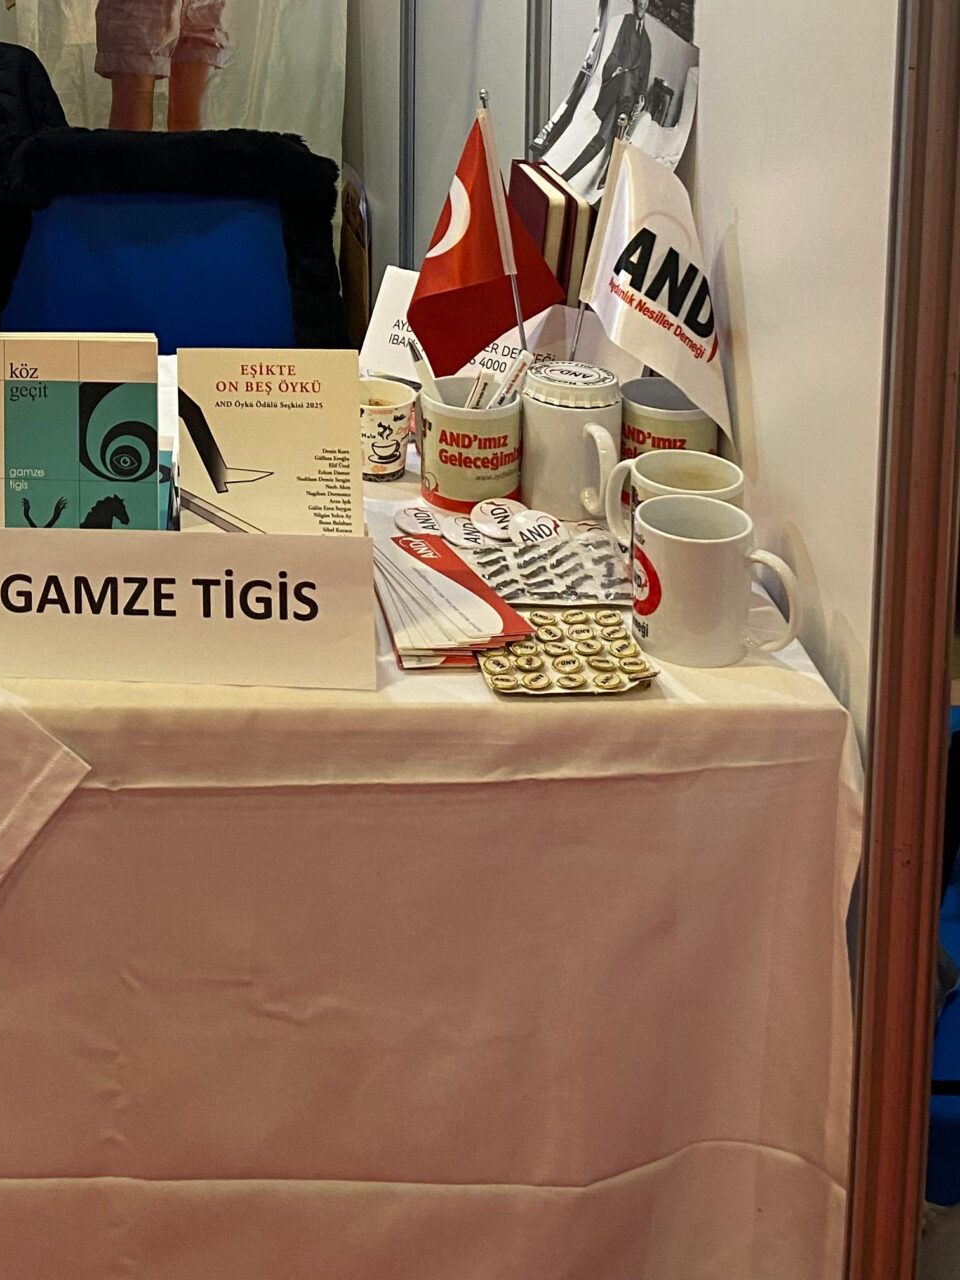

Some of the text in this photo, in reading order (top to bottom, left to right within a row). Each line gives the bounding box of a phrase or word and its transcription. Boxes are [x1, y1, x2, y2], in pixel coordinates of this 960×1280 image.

[613, 227, 715, 339] AND
[634, 298, 675, 332] Nesiller
[672, 324, 707, 360] Derneği
[9, 362, 40, 379] köz
[240, 362, 297, 378] EŞİKTE
[478, 356, 508, 374] 4000
[9, 382, 49, 402] geçit
[215, 379, 322, 396] ON BEŞ ÖYKÜ
[233, 399, 255, 410] Öykü
[255, 399, 278, 409] Ödülü
[9, 467, 46, 478] gamze
[413, 511, 440, 531] AND
[518, 523, 553, 546] AND
[408, 540, 440, 560] AND
[0, 568, 320, 622] GAMZE TİGİS
